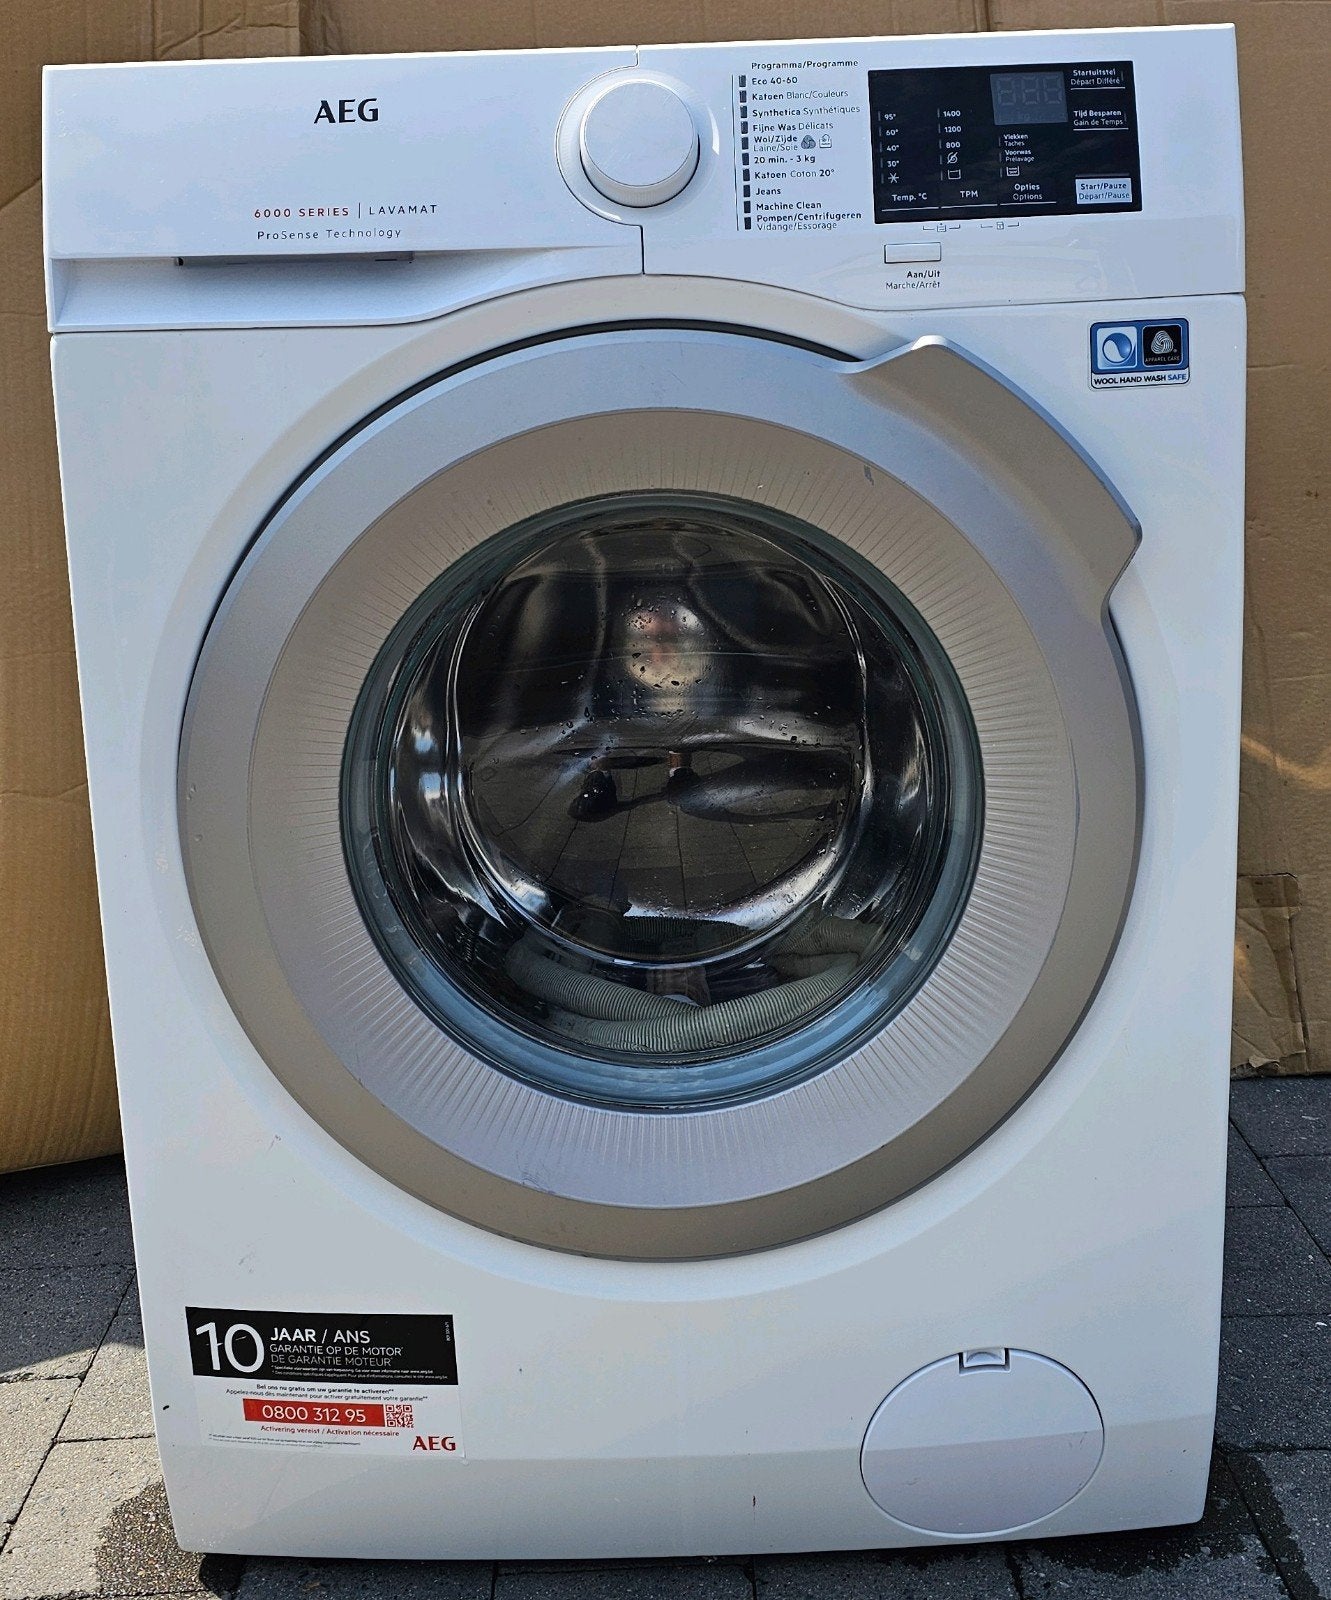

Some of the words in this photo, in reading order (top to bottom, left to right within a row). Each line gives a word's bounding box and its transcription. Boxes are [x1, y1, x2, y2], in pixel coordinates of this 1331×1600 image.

[752, 60, 859, 71] Programma/Programme
[1073, 68, 1116, 77] Startuitstel
[770, 76, 798, 84] 40-60
[752, 93, 784, 101] Katoen
[786, 90, 849, 99] Blanc/Couleurs
[314, 98, 379, 124] AEG
[752, 108, 800, 118] Synthetica
[803, 106, 860, 116] Synthétiques
[1073, 110, 1088, 118] Tijd
[1101, 118, 1123, 126] Temps
[753, 124, 775, 133] Fijne
[798, 122, 834, 130] Délicats
[754, 134, 798, 144] Wol/Zijde
[754, 144, 798, 152] Laine/Soie
[754, 156, 766, 164] 20
[796, 155, 801, 163] 3
[804, 155, 816, 163] kg
[790, 170, 817, 178] Coton
[820, 169, 835, 177] 20°
[1014, 183, 1040, 192] Opties
[1080, 182, 1127, 191] Start/Pauze
[756, 188, 781, 196] Jeans
[960, 190, 978, 198] TPM
[892, 194, 917, 202] Temp.
[1012, 193, 1043, 202] Options
[254, 208, 291, 218] 6000
[298, 207, 349, 217] SERIES
[369, 204, 437, 215] LAVAMAT
[756, 202, 794, 211] Machine
[796, 201, 822, 209] Clean
[756, 212, 862, 223] Pompen/Centrifugeren
[756, 222, 838, 232] Vidange/Essorage
[257, 230, 319, 240] ProSense
[326, 228, 401, 239] Technology
[906, 270, 940, 279] Aan/Uit
[886, 280, 940, 290] Marche/Arrêt
[1120, 376, 1142, 384] HAND
[270, 1327, 317, 1343] JAAR
[321, 1329, 328, 1344] /
[333, 1330, 371, 1344] ANS
[195, 1322, 265, 1373] 10
[269, 1343, 323, 1355] GARANTIE
[326, 1346, 341, 1355] OP
[345, 1346, 359, 1355] DE
[270, 1354, 285, 1364] DE
[288, 1355, 342, 1366] GARANTIE
[262, 1405, 309, 1420] 0800
[312, 1408, 341, 1422] 312
[345, 1408, 366, 1423] 95
[260, 1425, 296, 1434] Activering
[412, 1435, 456, 1451] AEG
